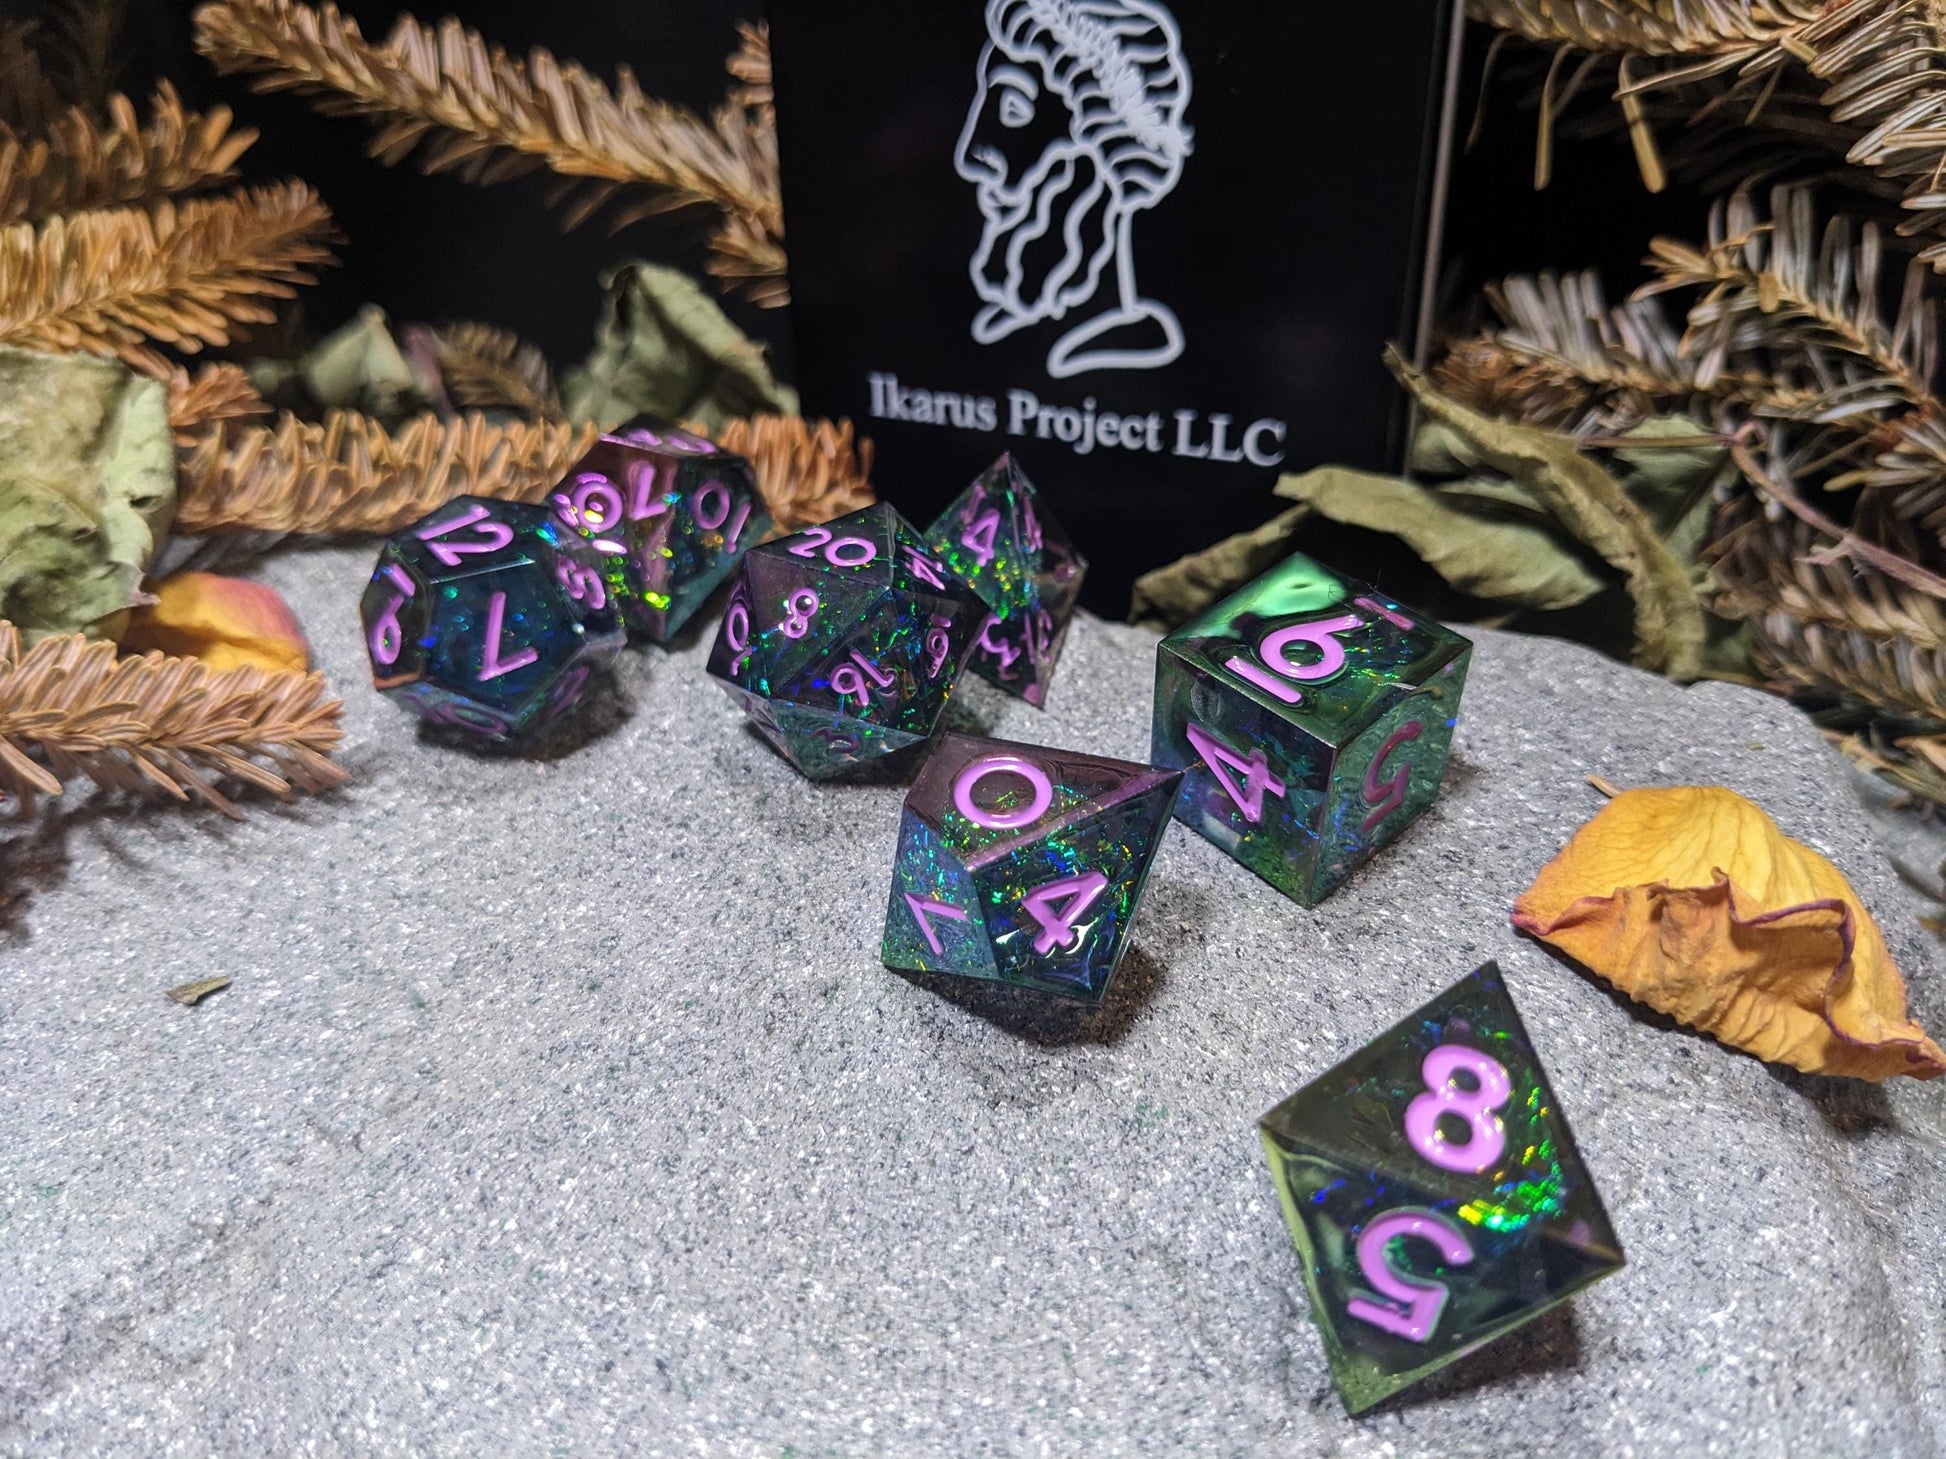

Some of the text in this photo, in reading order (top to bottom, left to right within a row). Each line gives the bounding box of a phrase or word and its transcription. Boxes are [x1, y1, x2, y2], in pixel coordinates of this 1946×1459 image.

[868, 371, 1288, 467] Ikarus Project LLC
[416, 504, 514, 566] 12
[789, 527, 877, 567] 20
[475, 591, 539, 682] 7
[781, 587, 820, 639] 8
[1186, 722, 1287, 824] 4
[1360, 719, 1424, 833] 5
[903, 891, 968, 957] 7
[1020, 870, 1109, 955] 4
[1405, 1044, 1512, 1175] 8
[1346, 1207, 1475, 1343] 5
